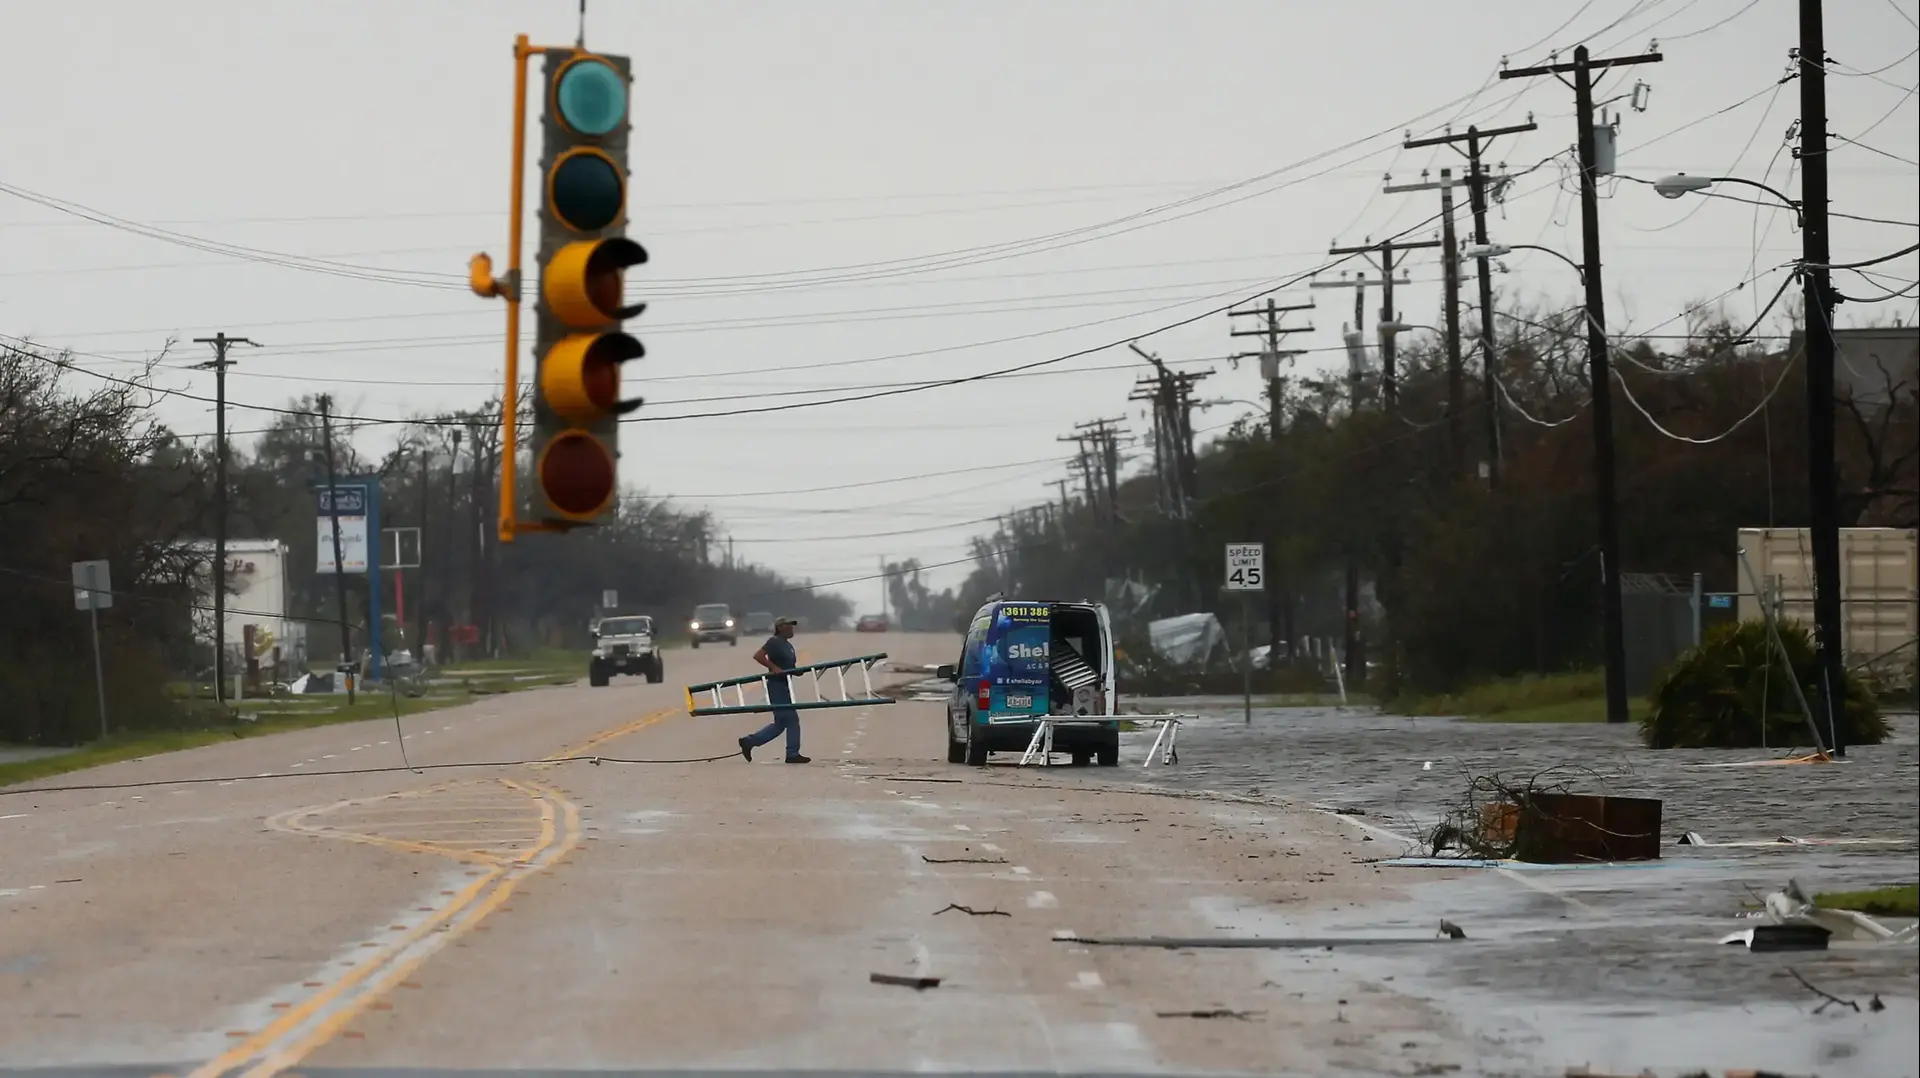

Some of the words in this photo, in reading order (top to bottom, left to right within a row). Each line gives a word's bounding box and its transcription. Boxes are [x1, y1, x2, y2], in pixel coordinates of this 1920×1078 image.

[1229, 548, 1261, 557] SPEED
[1232, 558, 1257, 566] LIMIT
[1229, 568, 1261, 585] 45
[1003, 607, 1027, 616] (361)
